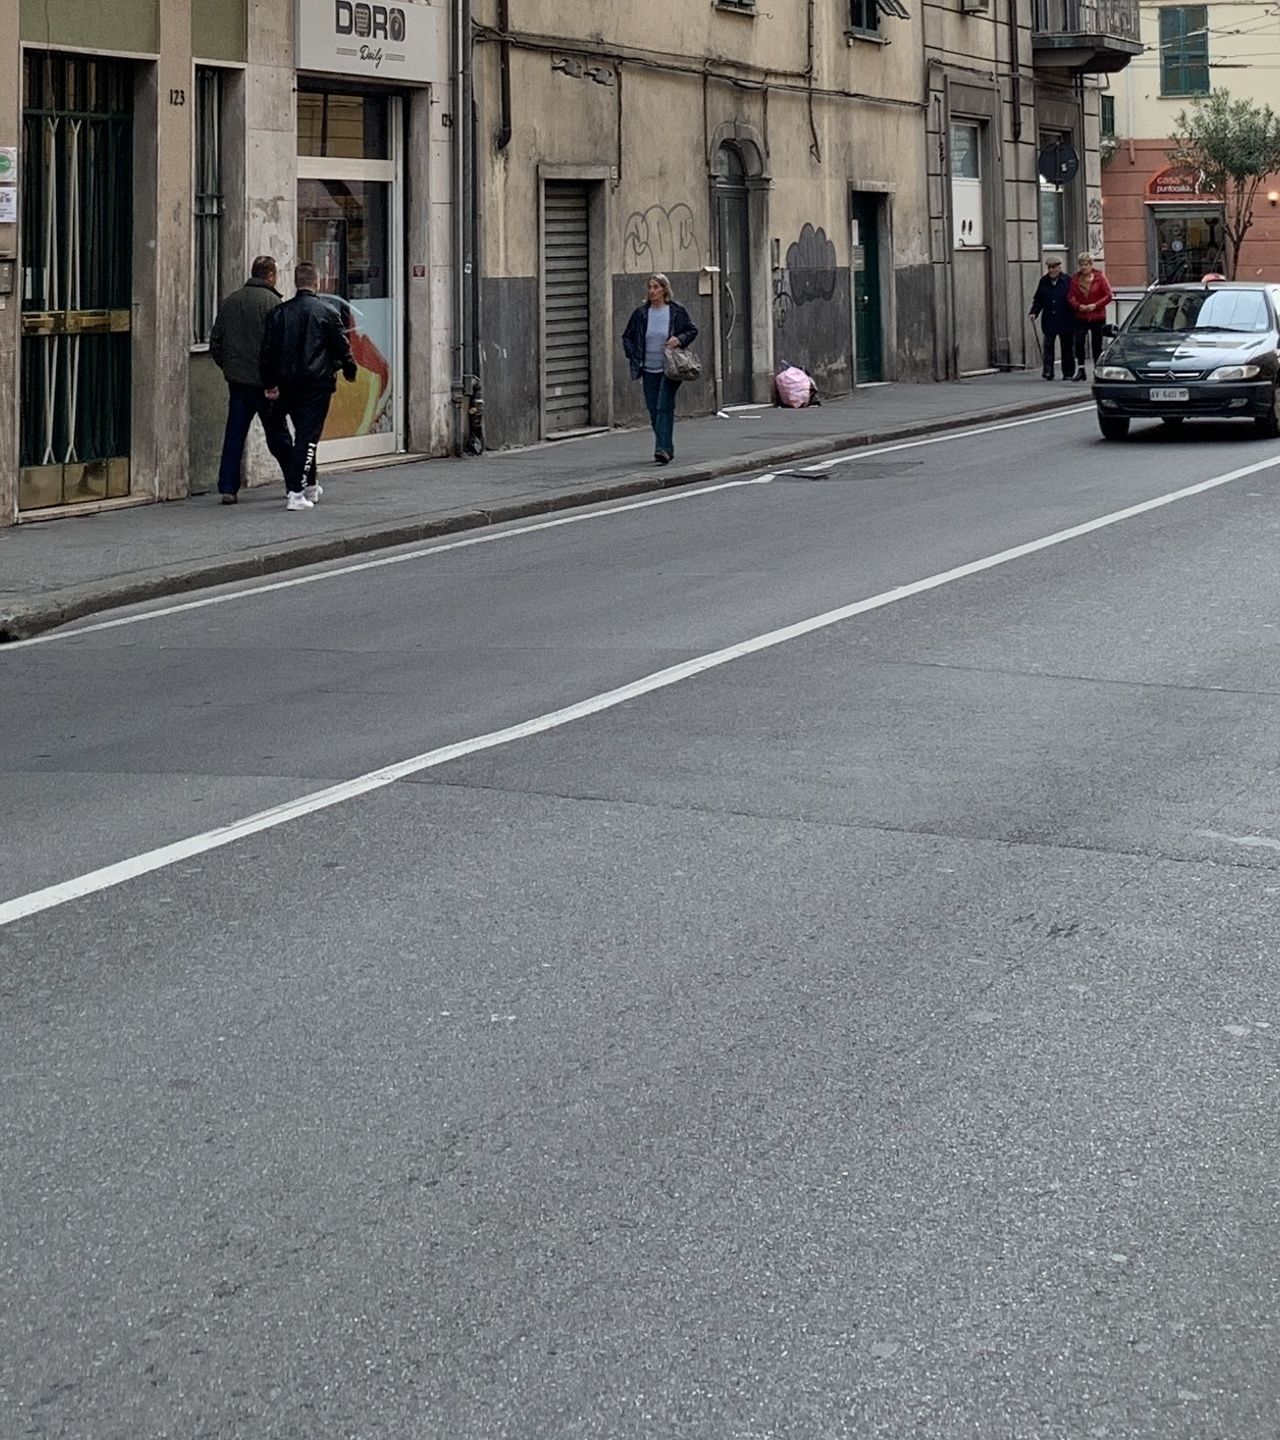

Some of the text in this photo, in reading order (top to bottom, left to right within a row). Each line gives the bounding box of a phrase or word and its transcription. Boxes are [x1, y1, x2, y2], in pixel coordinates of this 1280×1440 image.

[335, 0, 406, 42] DORO
[360, 44, 383, 69] Daily
[170, 89, 185, 106] 123
